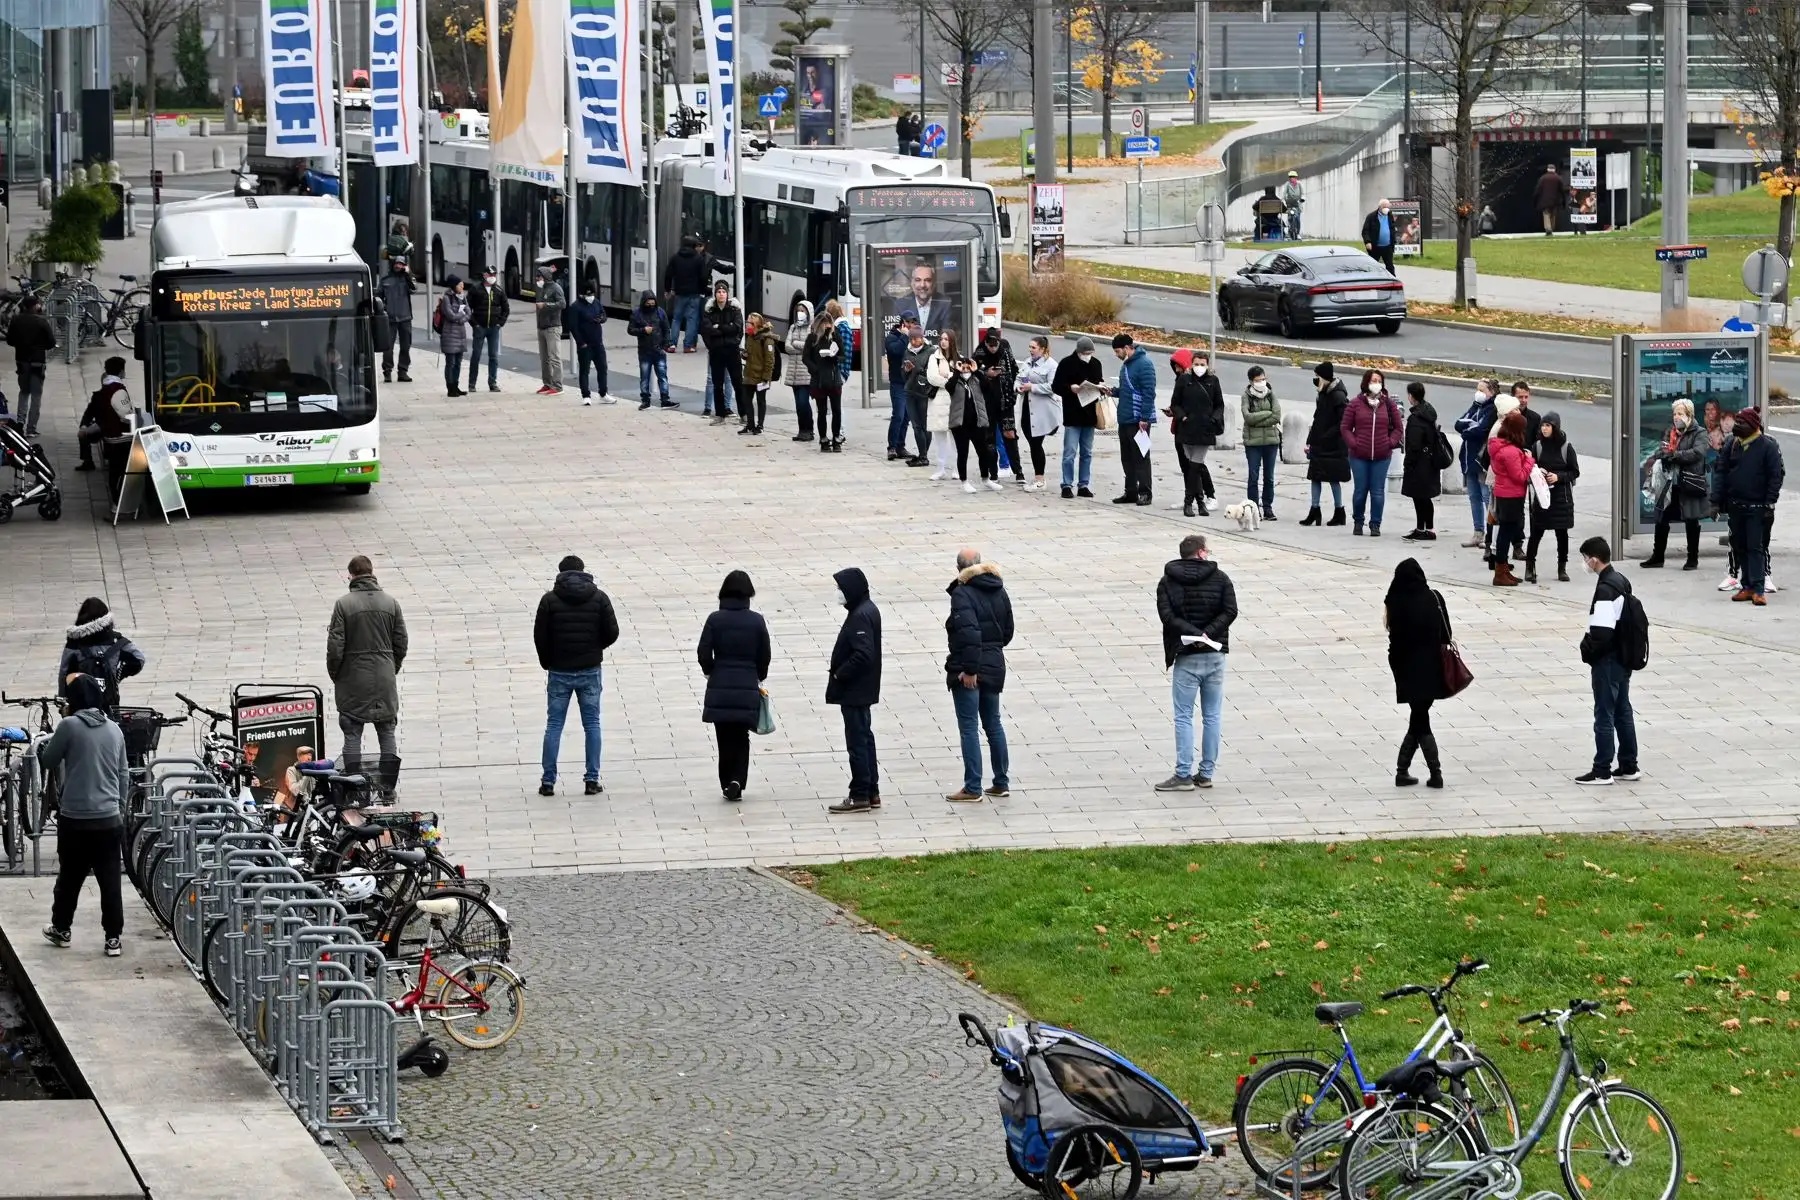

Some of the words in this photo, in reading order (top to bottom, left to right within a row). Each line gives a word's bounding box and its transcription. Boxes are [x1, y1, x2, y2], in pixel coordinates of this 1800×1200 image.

[698, 93, 705, 104] P
[1039, 187, 1060, 198] ZEIT
[174, 289, 238, 302] Impfbus:
[238, 287, 266, 300] Jede
[269, 286, 314, 300] Impfung
[317, 284, 350, 297] zählt!
[182, 301, 216, 313] Rotes
[219, 299, 252, 312] Kreuz
[264, 297, 290, 310] Land
[293, 297, 342, 309] Salzburg
[276, 436, 314, 446] albus
[246, 453, 290, 464] MAN
[246, 730, 276, 742] Friends
[276, 729, 287, 738] on
[288, 726, 307, 736] Tour
